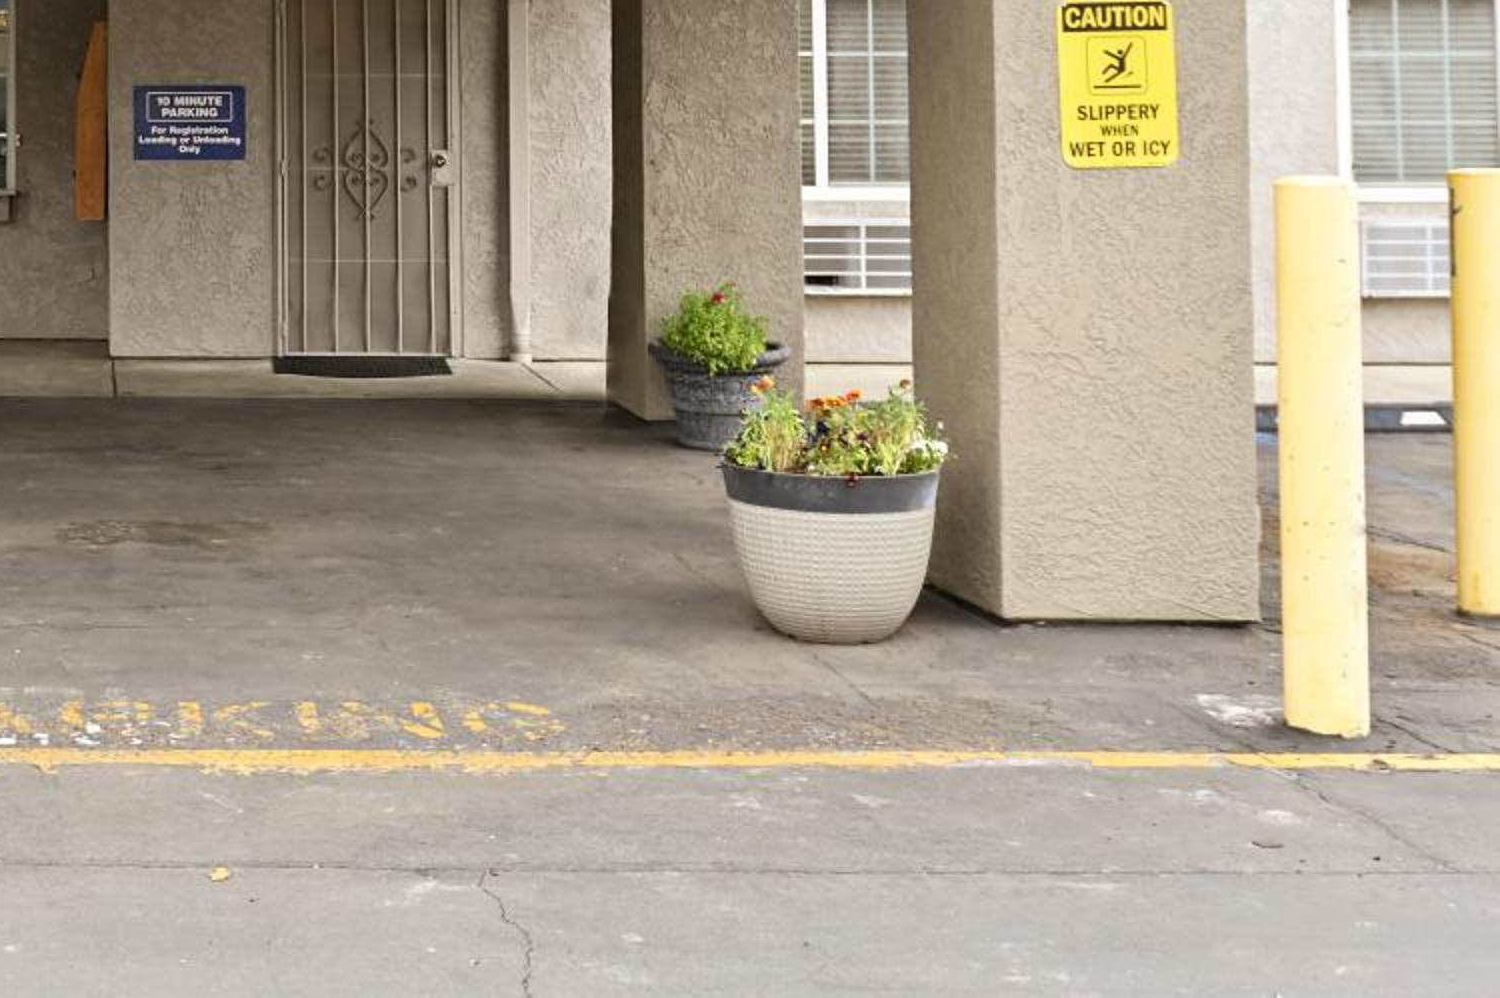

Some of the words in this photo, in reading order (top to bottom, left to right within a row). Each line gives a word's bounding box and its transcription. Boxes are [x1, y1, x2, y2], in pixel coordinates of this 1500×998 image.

[1064, 5, 1165, 29] CAUTION
[156, 96, 171, 107] 10
[173, 95, 223, 107] MINUTE
[161, 107, 219, 118] PARKING
[1077, 104, 1160, 121] SLIPPERY
[151, 125, 167, 135] For
[169, 125, 229, 136] Registration
[1101, 124, 1140, 137] WHEN
[138, 135, 177, 146] Loading
[193, 135, 241, 146] Unloading
[179, 145, 201, 155] Only
[1069, 141, 1106, 157] WET
[1111, 141, 1136, 157] OR
[1143, 140, 1171, 156] ICY
